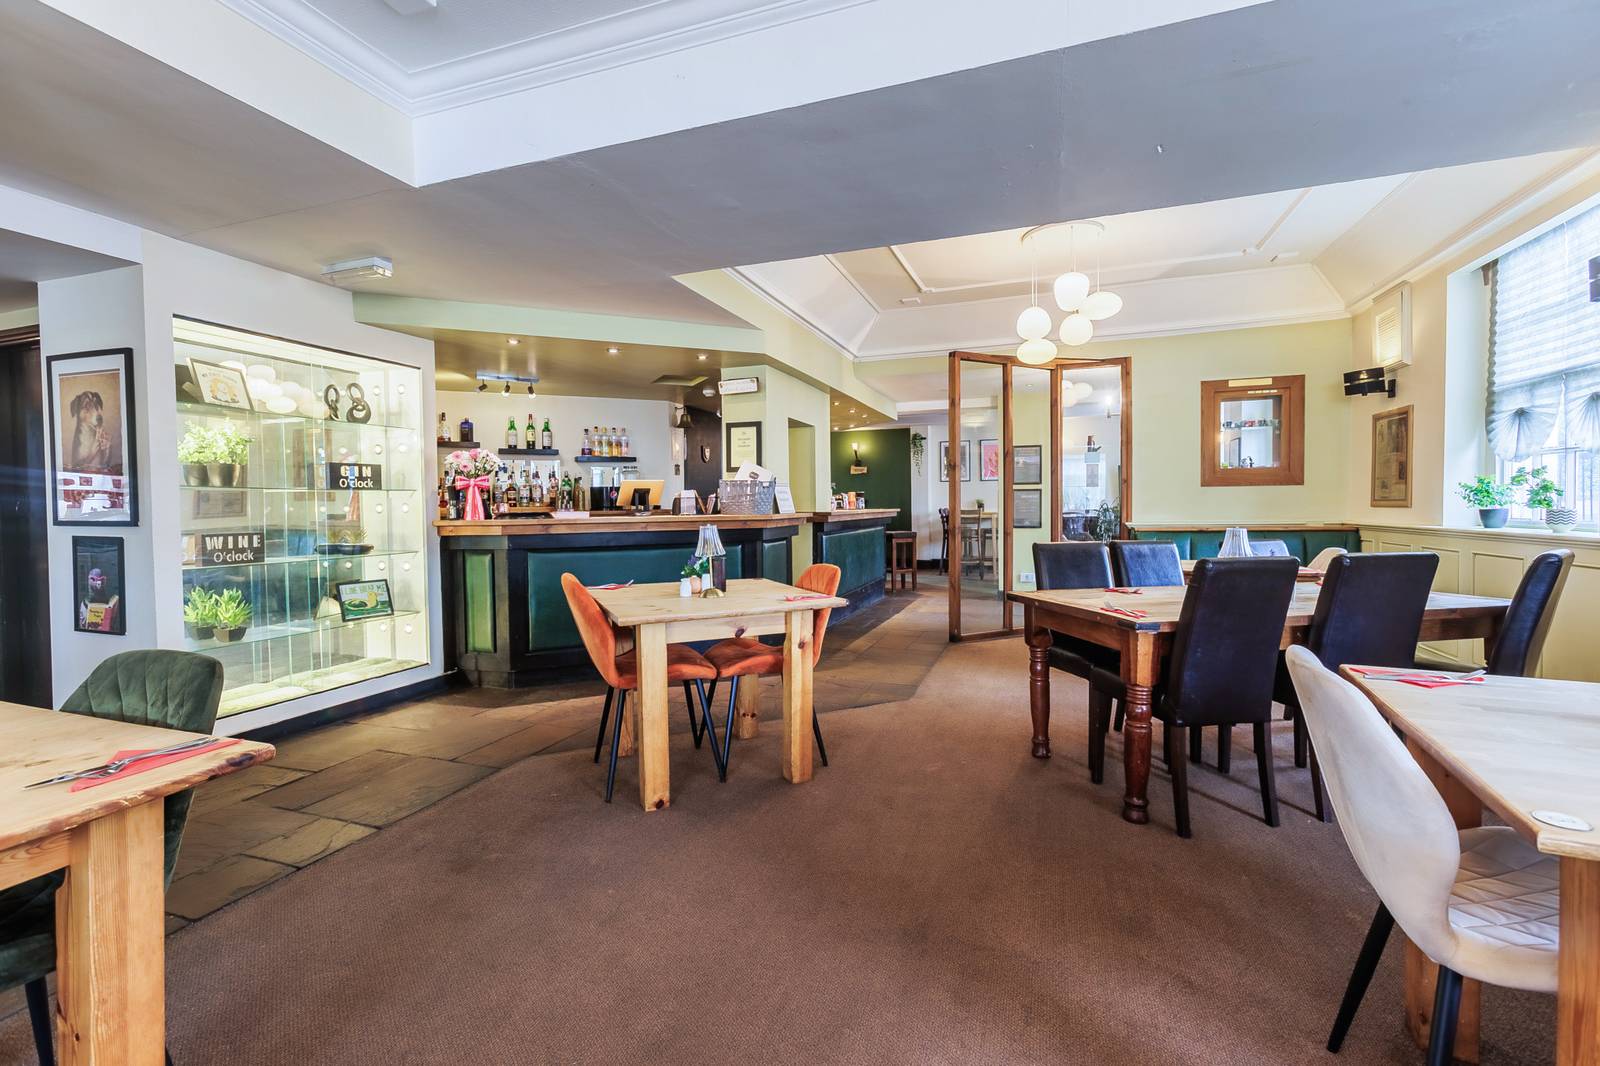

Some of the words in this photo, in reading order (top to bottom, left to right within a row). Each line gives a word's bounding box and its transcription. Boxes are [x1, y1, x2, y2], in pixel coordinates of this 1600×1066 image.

[341, 465, 372, 477] GIN
[339, 478, 374, 488] O'clock
[205, 535, 261, 550] WINE
[213, 549, 254, 563] O'clock
